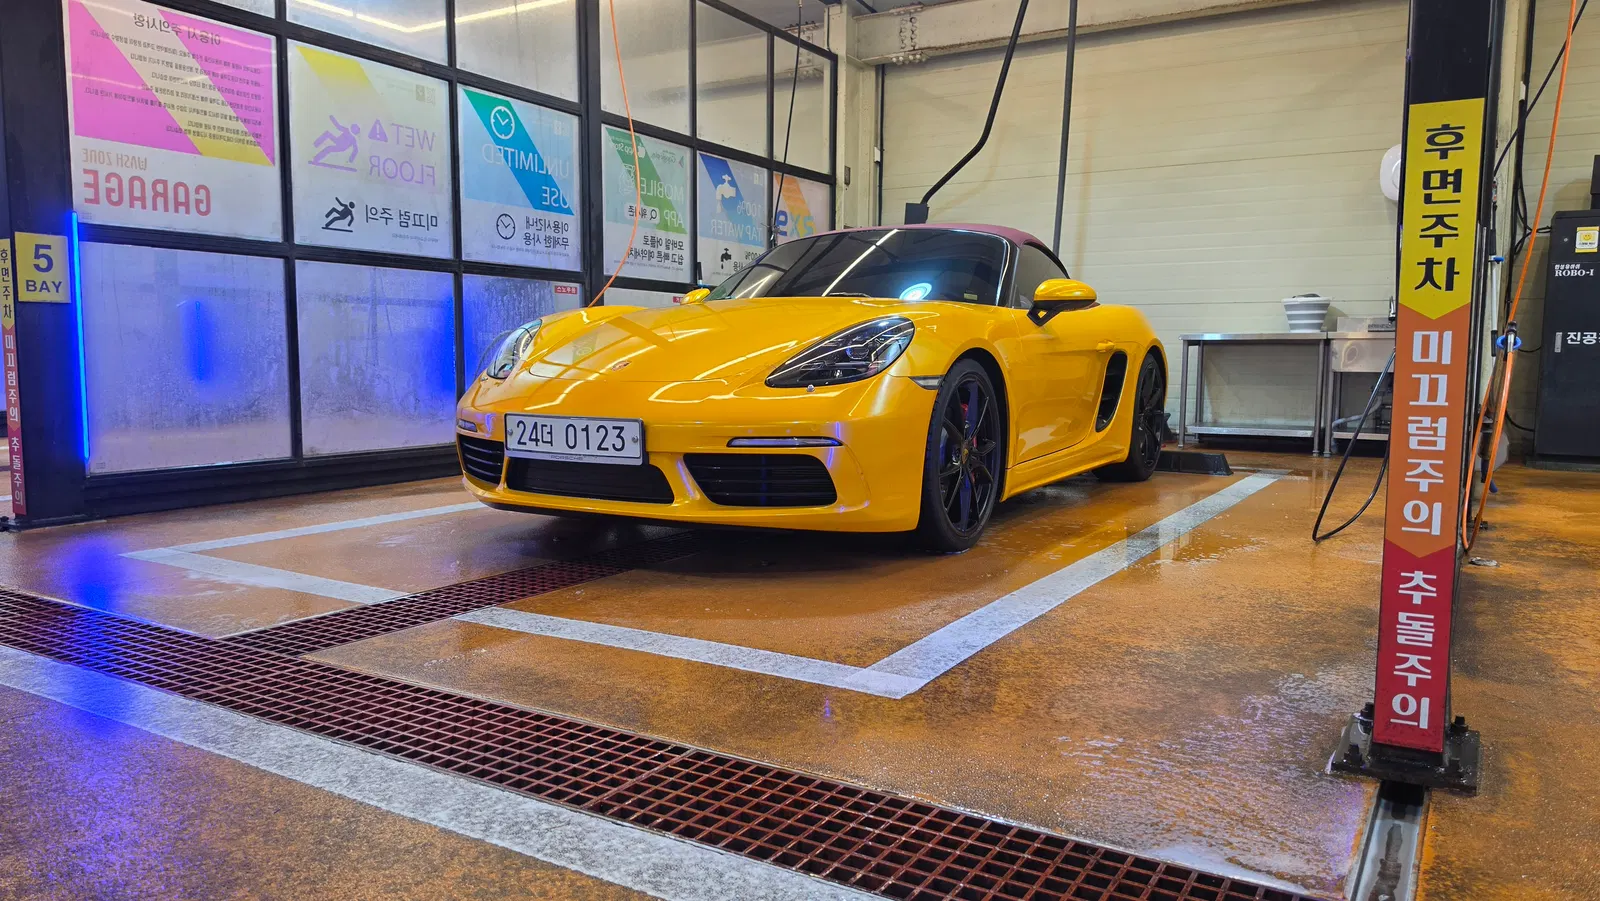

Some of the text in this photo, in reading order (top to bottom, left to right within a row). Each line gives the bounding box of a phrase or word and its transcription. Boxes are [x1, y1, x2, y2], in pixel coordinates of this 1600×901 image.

[1413, 123, 1466, 292] 후면주차
[0, 248, 12, 320] 후면주차
[25, 279, 63, 294] BAY
[33, 243, 54, 273] 5
[1554, 268, 1594, 277] ROBO-I
[1566, 331, 1600, 345] 진공
[4, 333, 19, 423] 미끄럼주의
[516, 420, 626, 452] 24더 0123
[1401, 329, 1452, 537] 미끄럼주의
[11, 436, 25, 507] 추돌주의
[1389, 569, 1438, 731] 추돌주의
